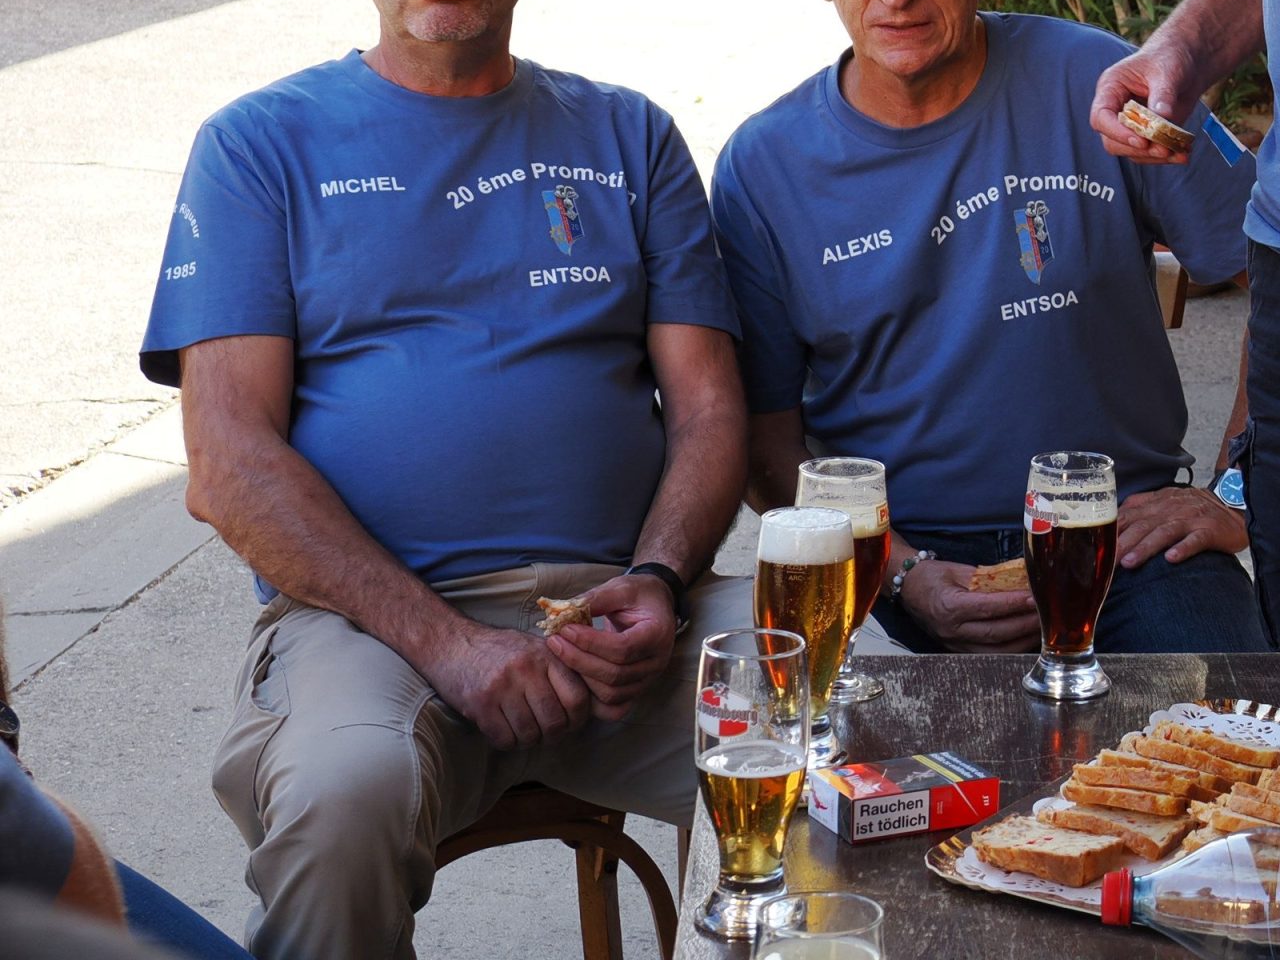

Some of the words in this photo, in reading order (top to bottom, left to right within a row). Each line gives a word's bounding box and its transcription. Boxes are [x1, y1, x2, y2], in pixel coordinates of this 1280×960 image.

[320, 176, 406, 198] MICHEL
[446, 185, 475, 210] 20
[477, 167, 527, 195] éme
[530, 162, 637, 206] Promoti
[179, 202, 200, 239] Rigueur
[931, 215, 955, 245] 20
[956, 186, 1000, 220] éme
[1003, 173, 1115, 203] Promotion
[822, 229, 893, 265] ALEXIS
[165, 261, 197, 280] 1985
[529, 266, 612, 288] ENTSOA
[1000, 290, 1079, 321] ENTSOA
[860, 798, 924, 817] Rauchen
[855, 821, 873, 836] ist
[877, 813, 927, 832] tödlich
